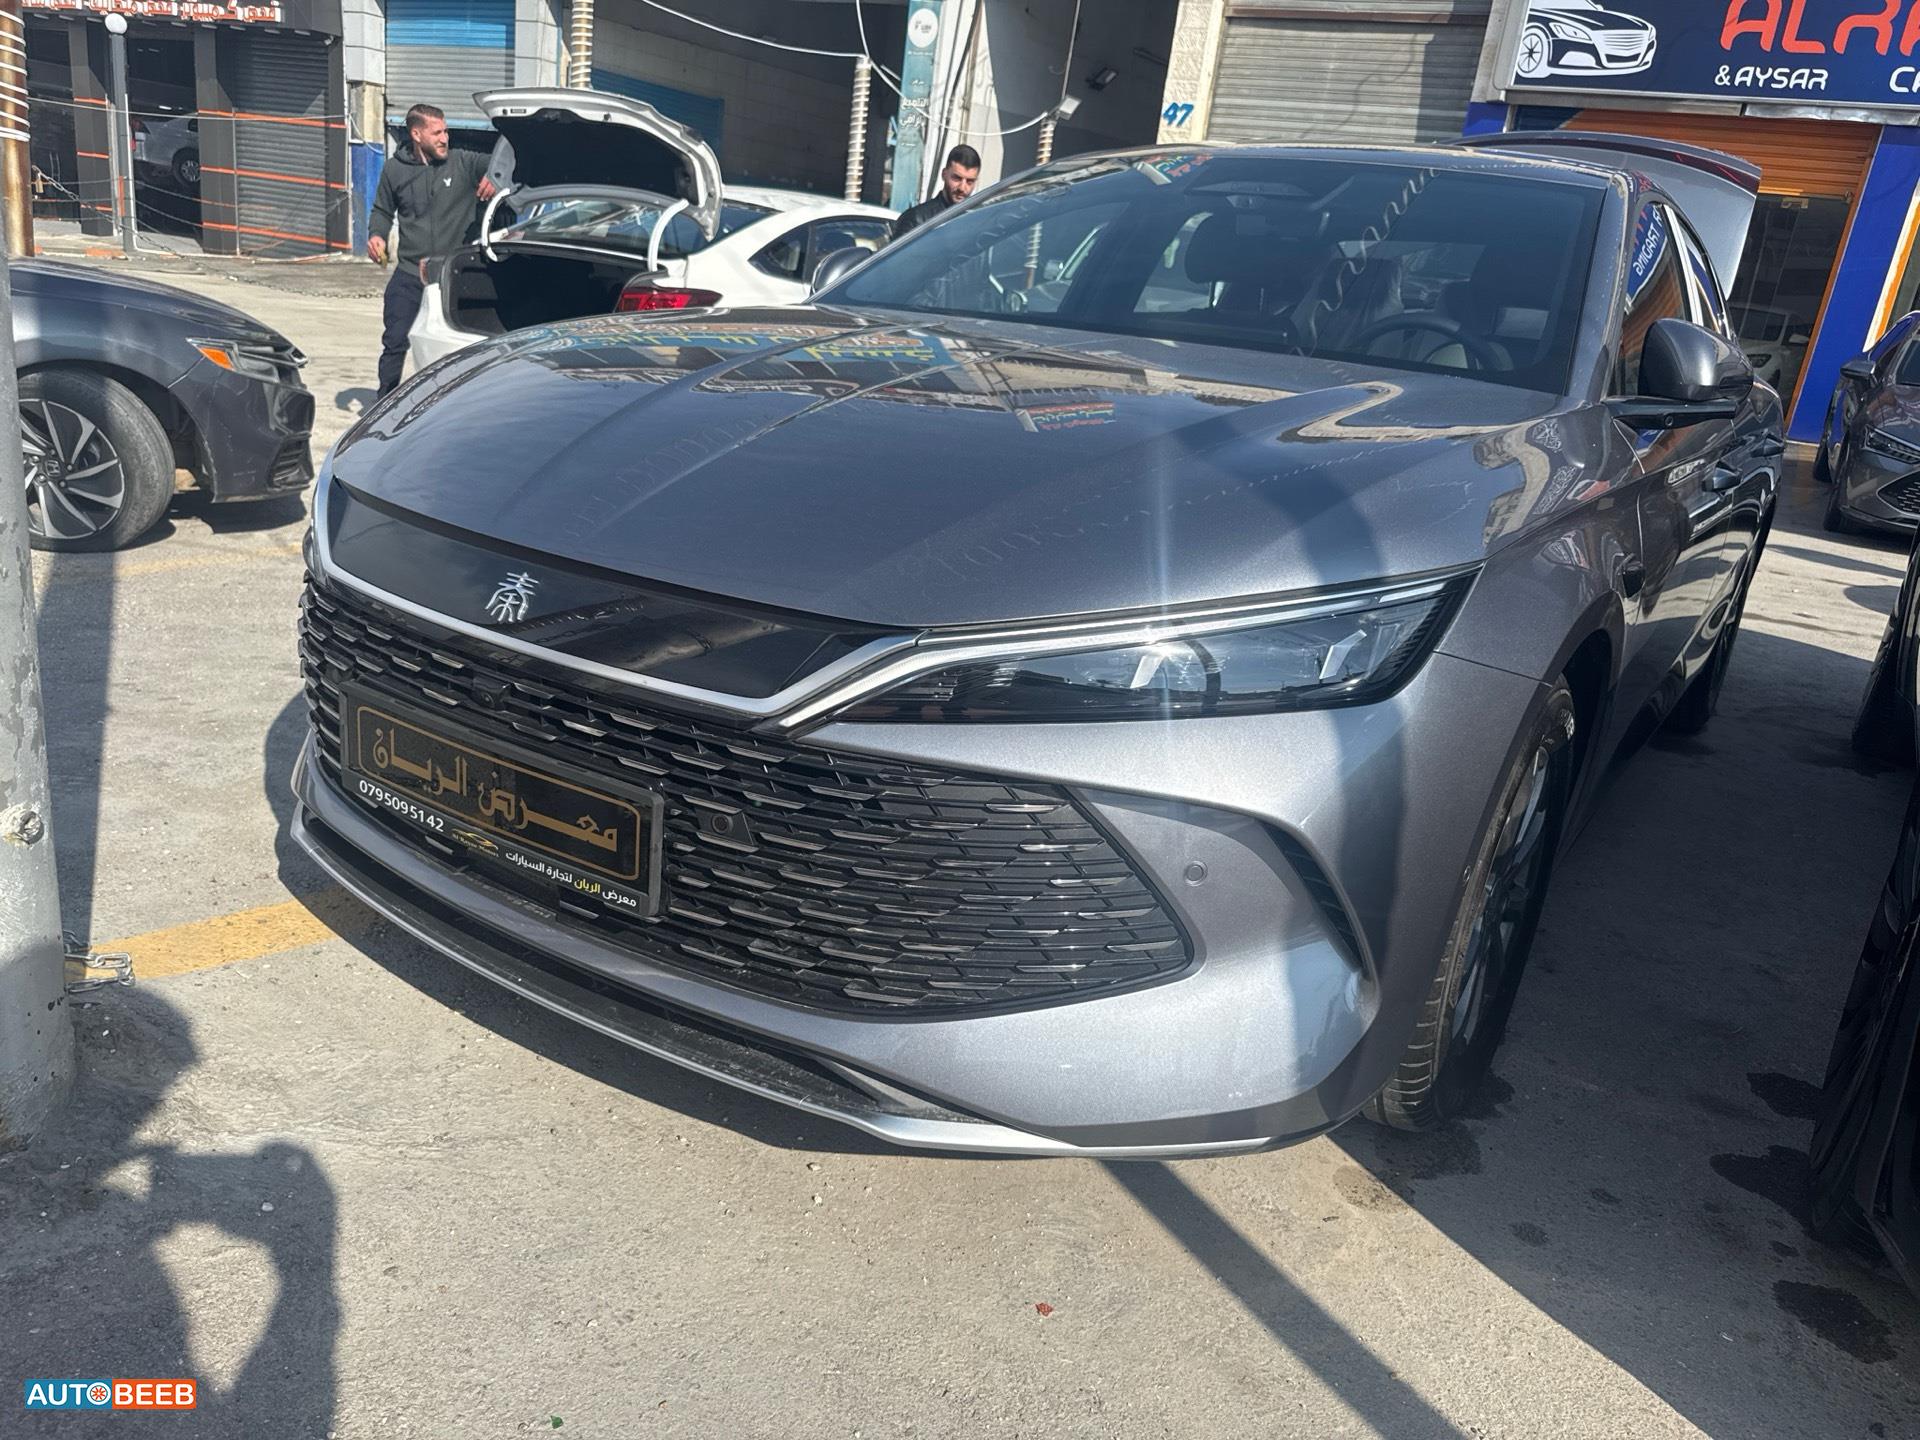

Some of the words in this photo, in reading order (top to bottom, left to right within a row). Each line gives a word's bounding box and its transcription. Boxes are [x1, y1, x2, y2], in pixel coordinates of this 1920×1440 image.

[1734, 66, 1829, 91] AYSAR
[1163, 102, 1194, 127] 47
[373, 728, 467, 797] الريان
[359, 780, 444, 832] 0795095142
[478, 771, 618, 853] معرض
[505, 852, 545, 873] السيارات
[546, 866, 573, 883] لتجارة
[574, 878, 601, 894] الريان
[602, 889, 637, 908] معرض
